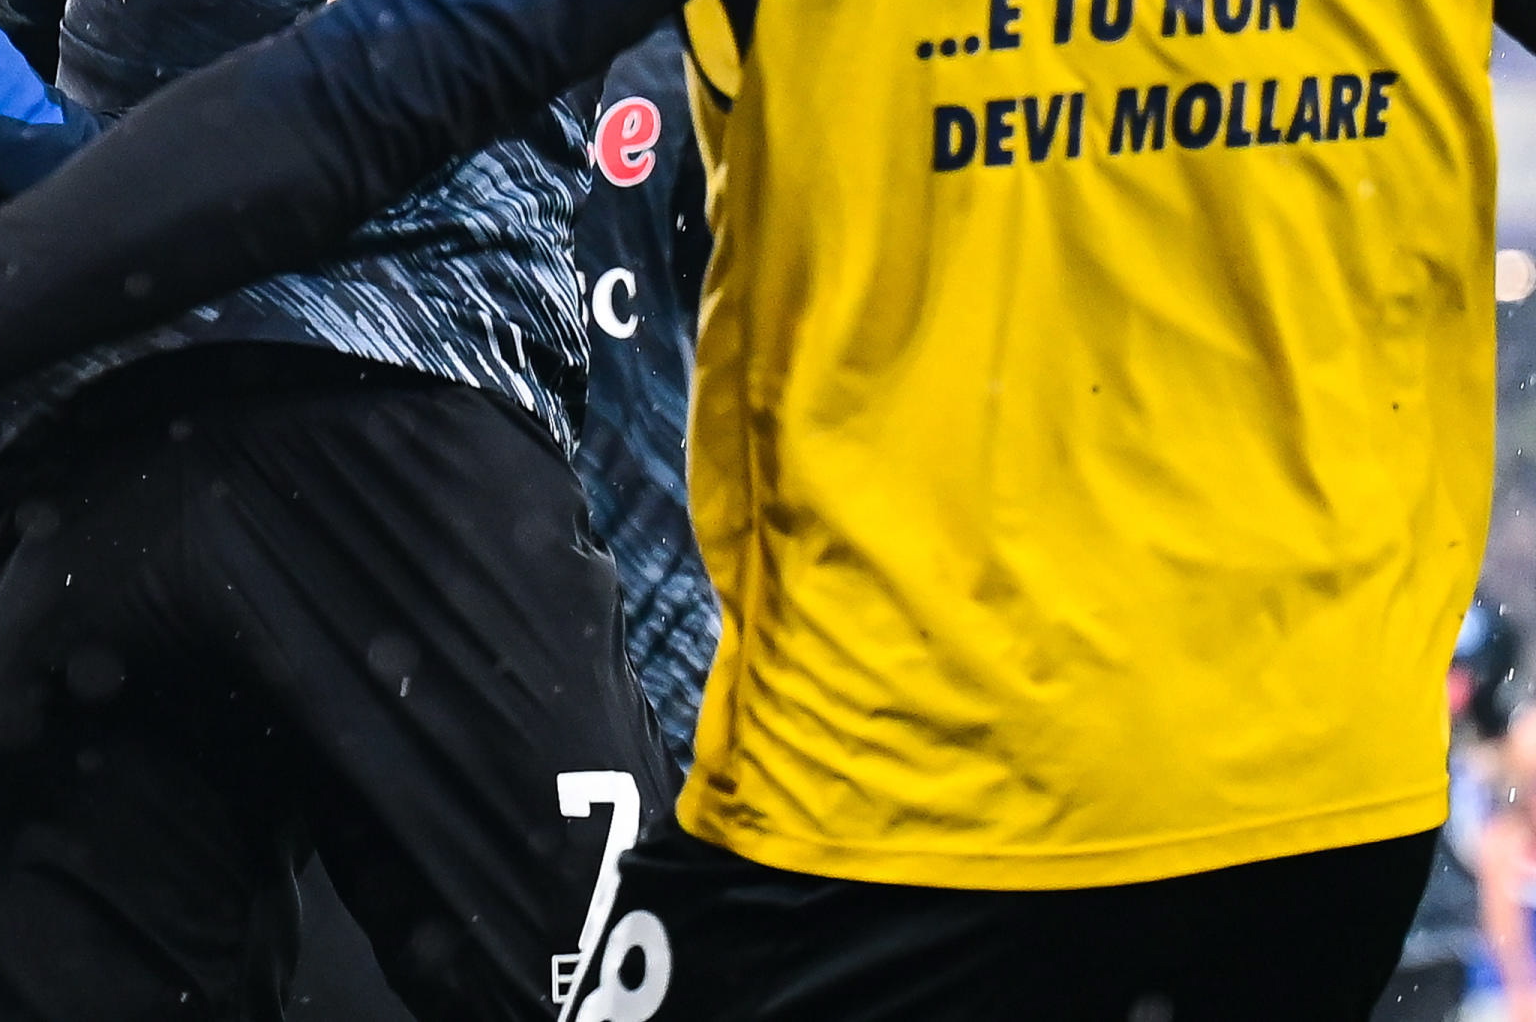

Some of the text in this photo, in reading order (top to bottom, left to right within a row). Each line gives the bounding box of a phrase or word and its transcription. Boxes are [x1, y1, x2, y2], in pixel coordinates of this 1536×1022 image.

[931, 71, 1400, 172] DEVI MOLLARE
[557, 770, 641, 1022] 7
